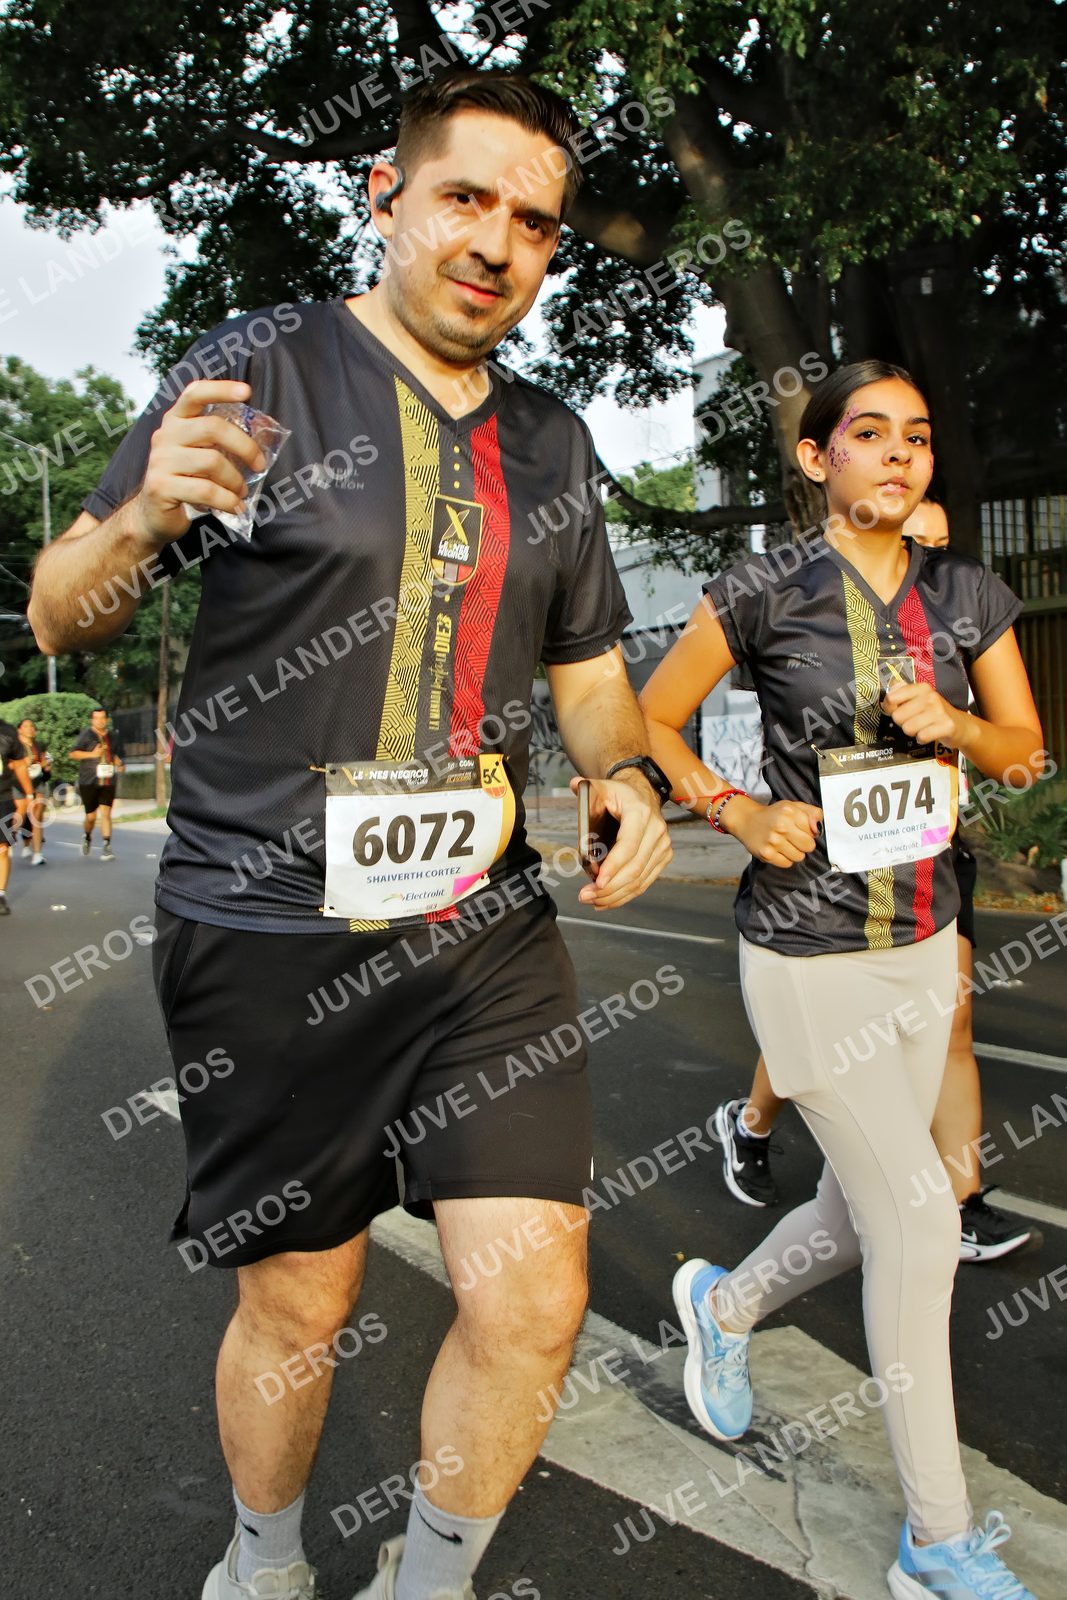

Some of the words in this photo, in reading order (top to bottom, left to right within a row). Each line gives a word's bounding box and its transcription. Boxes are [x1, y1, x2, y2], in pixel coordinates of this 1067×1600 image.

[865, 748, 894, 759] NEGROS
[390, 768, 429, 780] NEGROS
[844, 776, 935, 828] 6074
[352, 810, 475, 867] 6072
[858, 828, 900, 841] VALENTINA
[902, 822, 928, 835] CORTEZ
[367, 872, 423, 884] SHAIVERTH
[425, 866, 462, 879] CORTEZ
